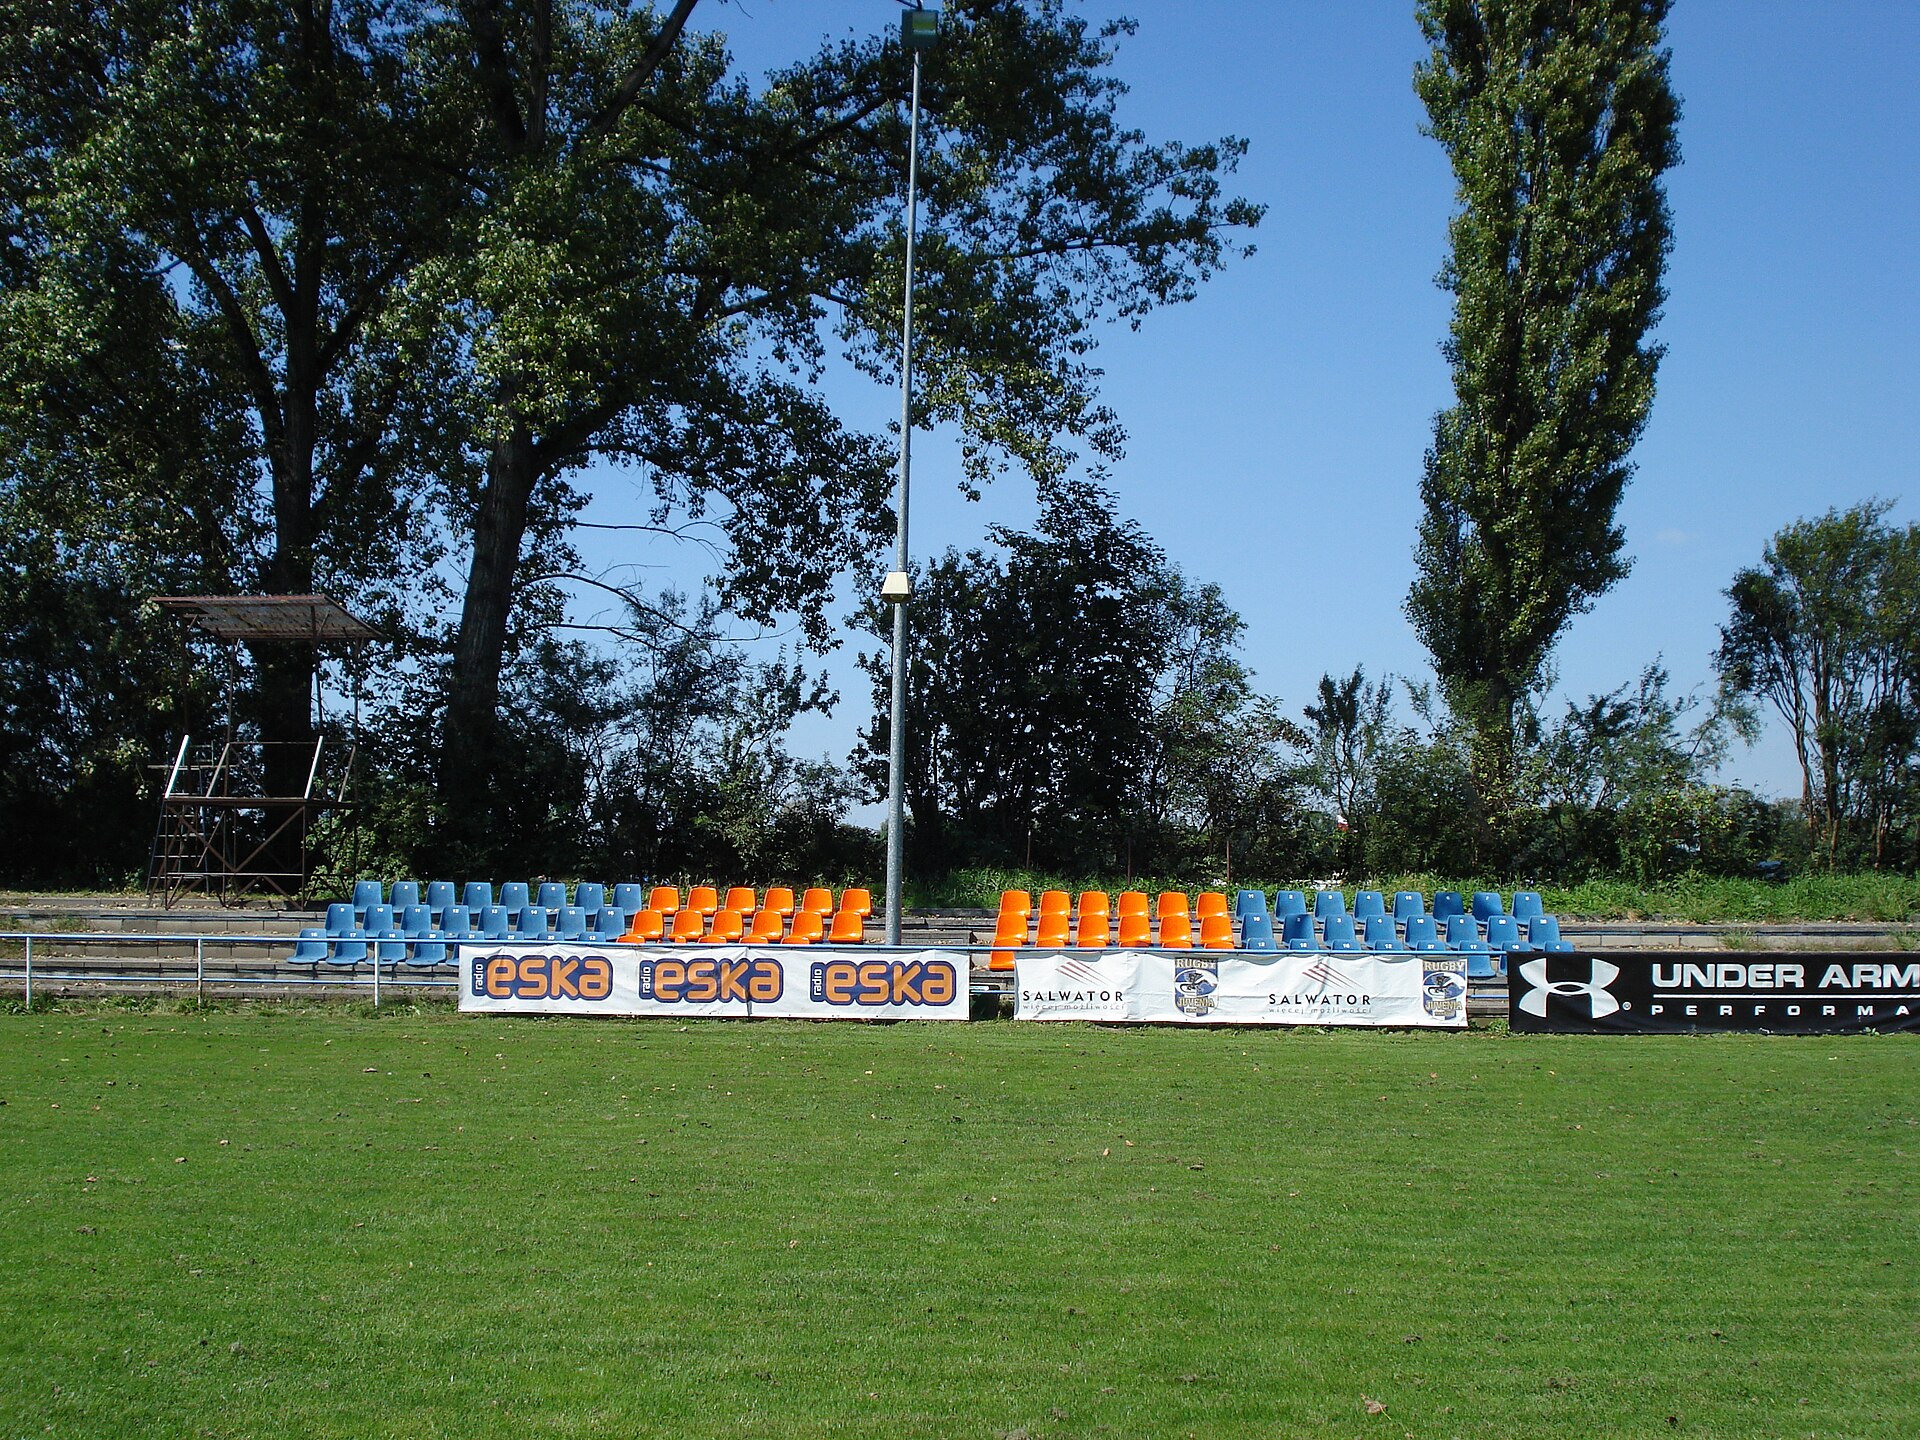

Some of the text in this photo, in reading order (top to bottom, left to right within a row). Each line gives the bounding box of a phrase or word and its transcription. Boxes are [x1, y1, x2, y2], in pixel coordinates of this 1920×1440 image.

[474, 964, 483, 990] radio
[487, 958, 610, 997] eska
[1424, 961, 1465, 971] RUGBY
[1652, 963, 1920, 988] UNDER ARM
[641, 967, 651, 993] radio
[654, 962, 780, 999] eska
[812, 968, 822, 996] radio
[826, 964, 953, 1002] eska
[1022, 990, 1123, 1001] SALWATOR
[1177, 997, 1215, 1008] JUVENIA
[1269, 993, 1371, 1005] SALWATOR
[1425, 1001, 1463, 1011] JUVENIA
[1651, 1005, 1910, 1016] PERFORMA
